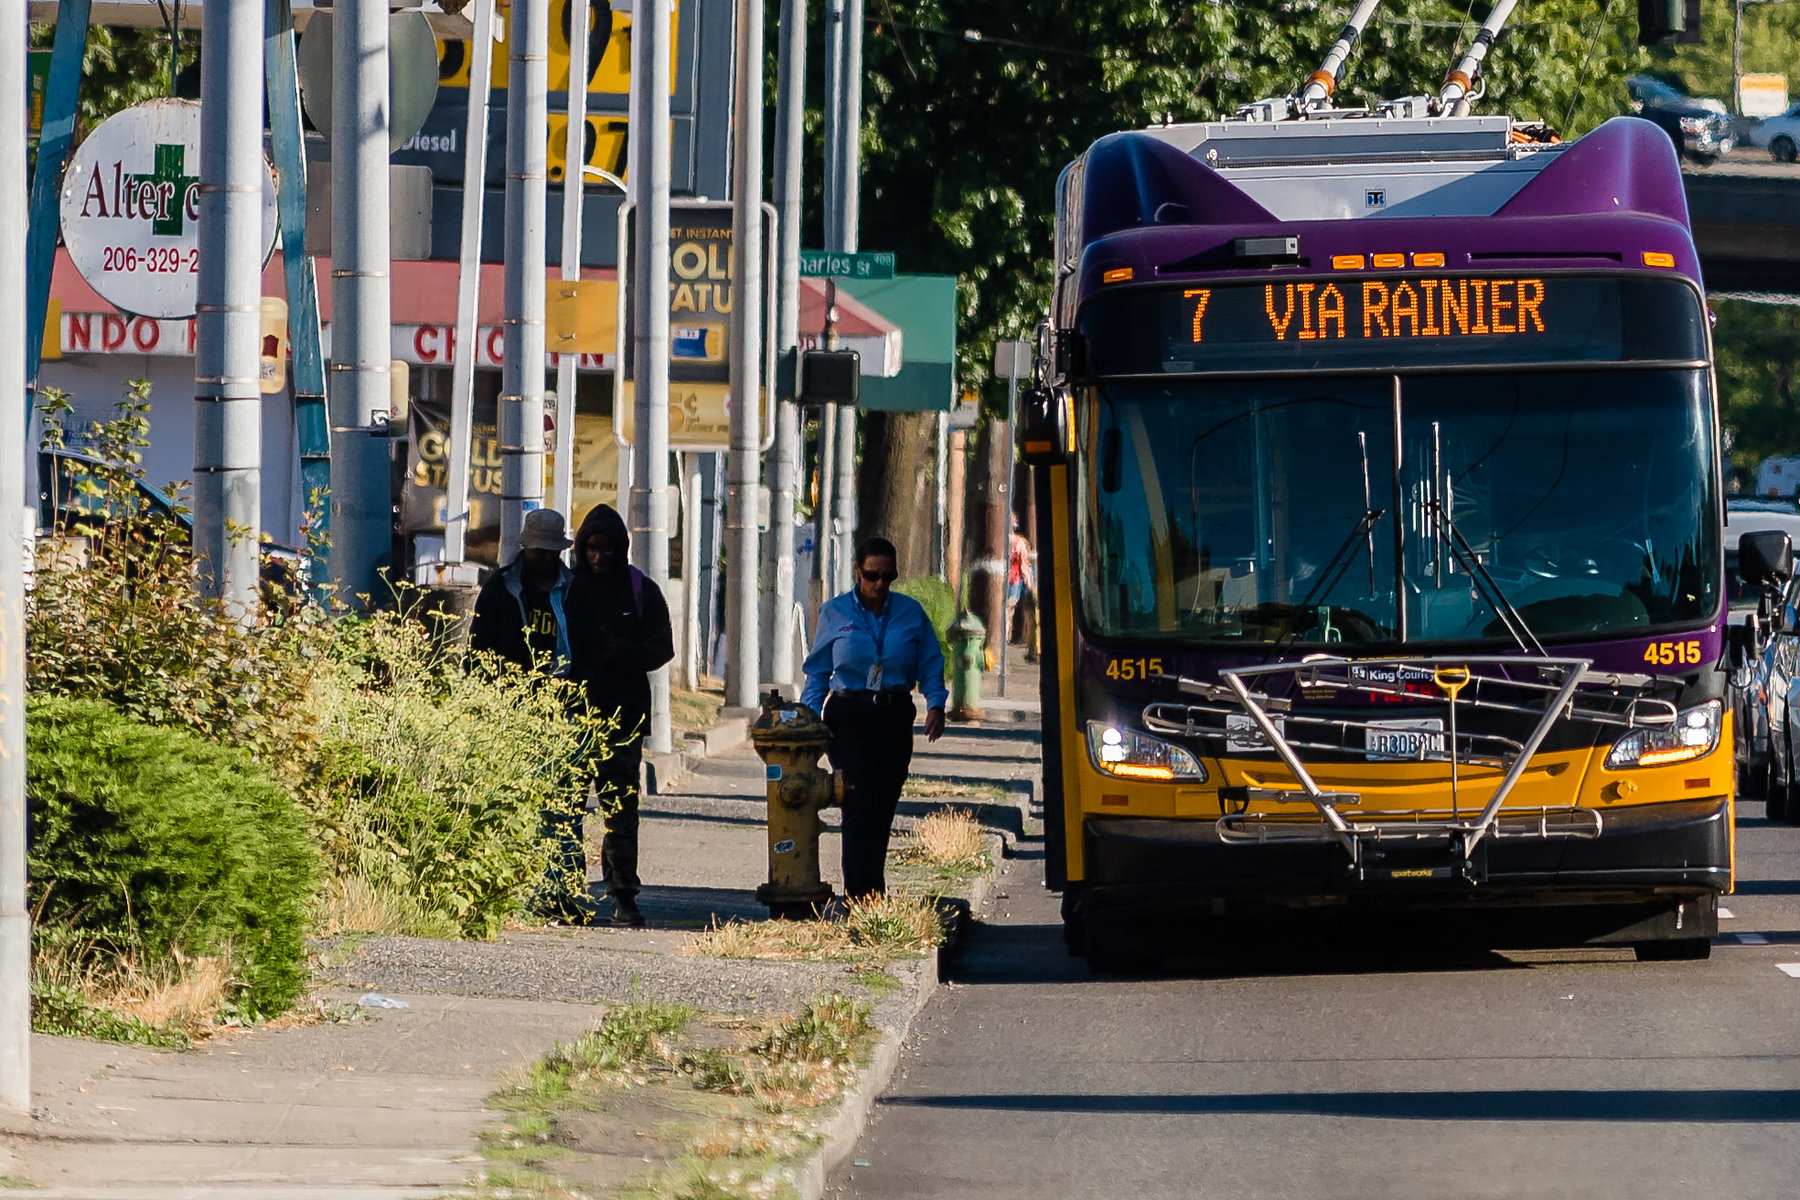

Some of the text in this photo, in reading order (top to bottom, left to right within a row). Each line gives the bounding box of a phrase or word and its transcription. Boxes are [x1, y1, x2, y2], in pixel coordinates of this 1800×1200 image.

[79, 159, 176, 221] Alter
[856, 260, 871, 276] St
[1184, 278, 1545, 343] 7 VIA RAINIER
[1105, 640, 1702, 680] 4515 4515
[1369, 670, 1395, 683] King
